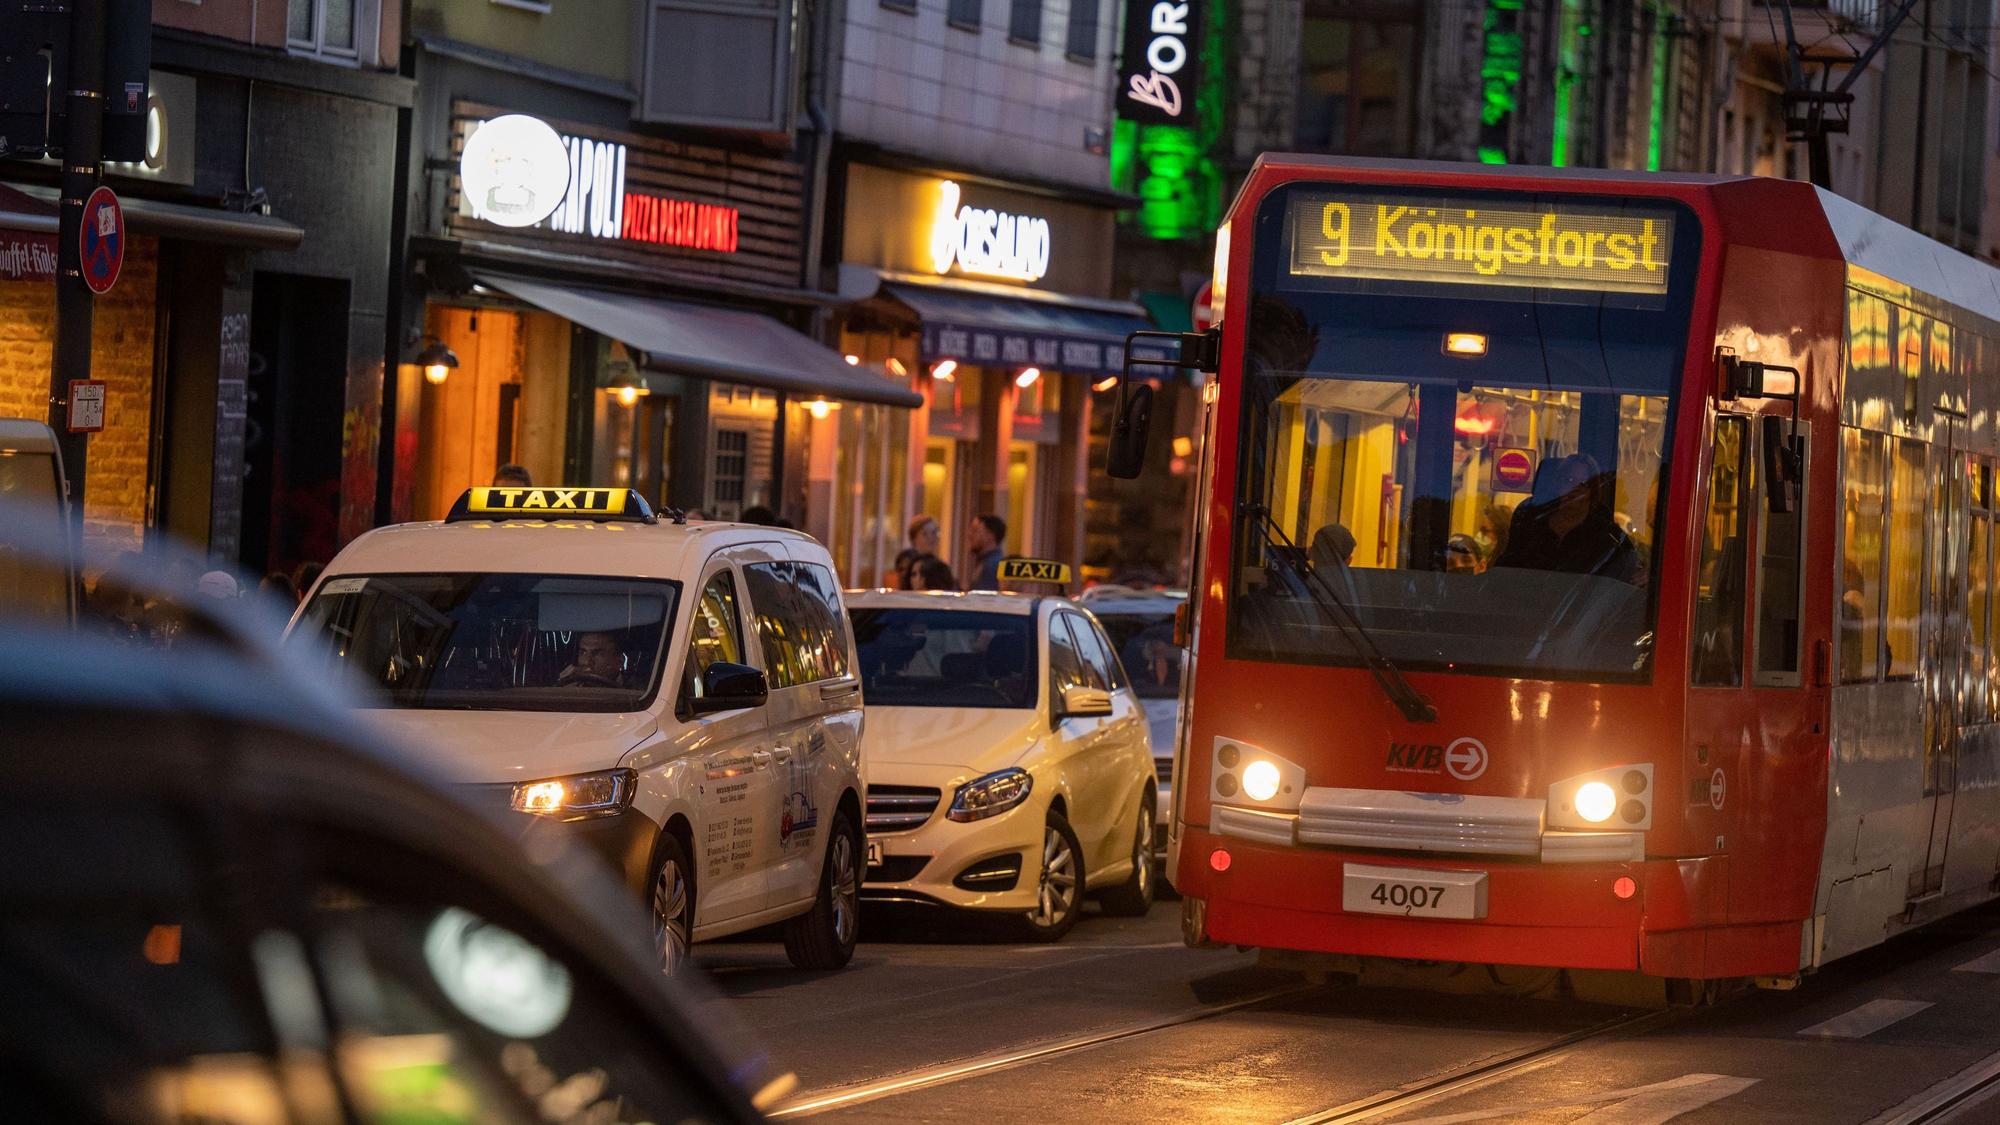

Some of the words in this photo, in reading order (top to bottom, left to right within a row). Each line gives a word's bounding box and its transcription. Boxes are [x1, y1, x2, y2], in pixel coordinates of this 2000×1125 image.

[1127, 0, 1190, 117] BOR
[1321, 202, 1351, 267] 9
[1375, 204, 1658, 276] Königsforst
[500, 490, 595, 509] TAXI
[1010, 562, 1056, 579] TAXI
[1386, 743, 1443, 769] KVB
[1371, 883, 1445, 909] 4007
